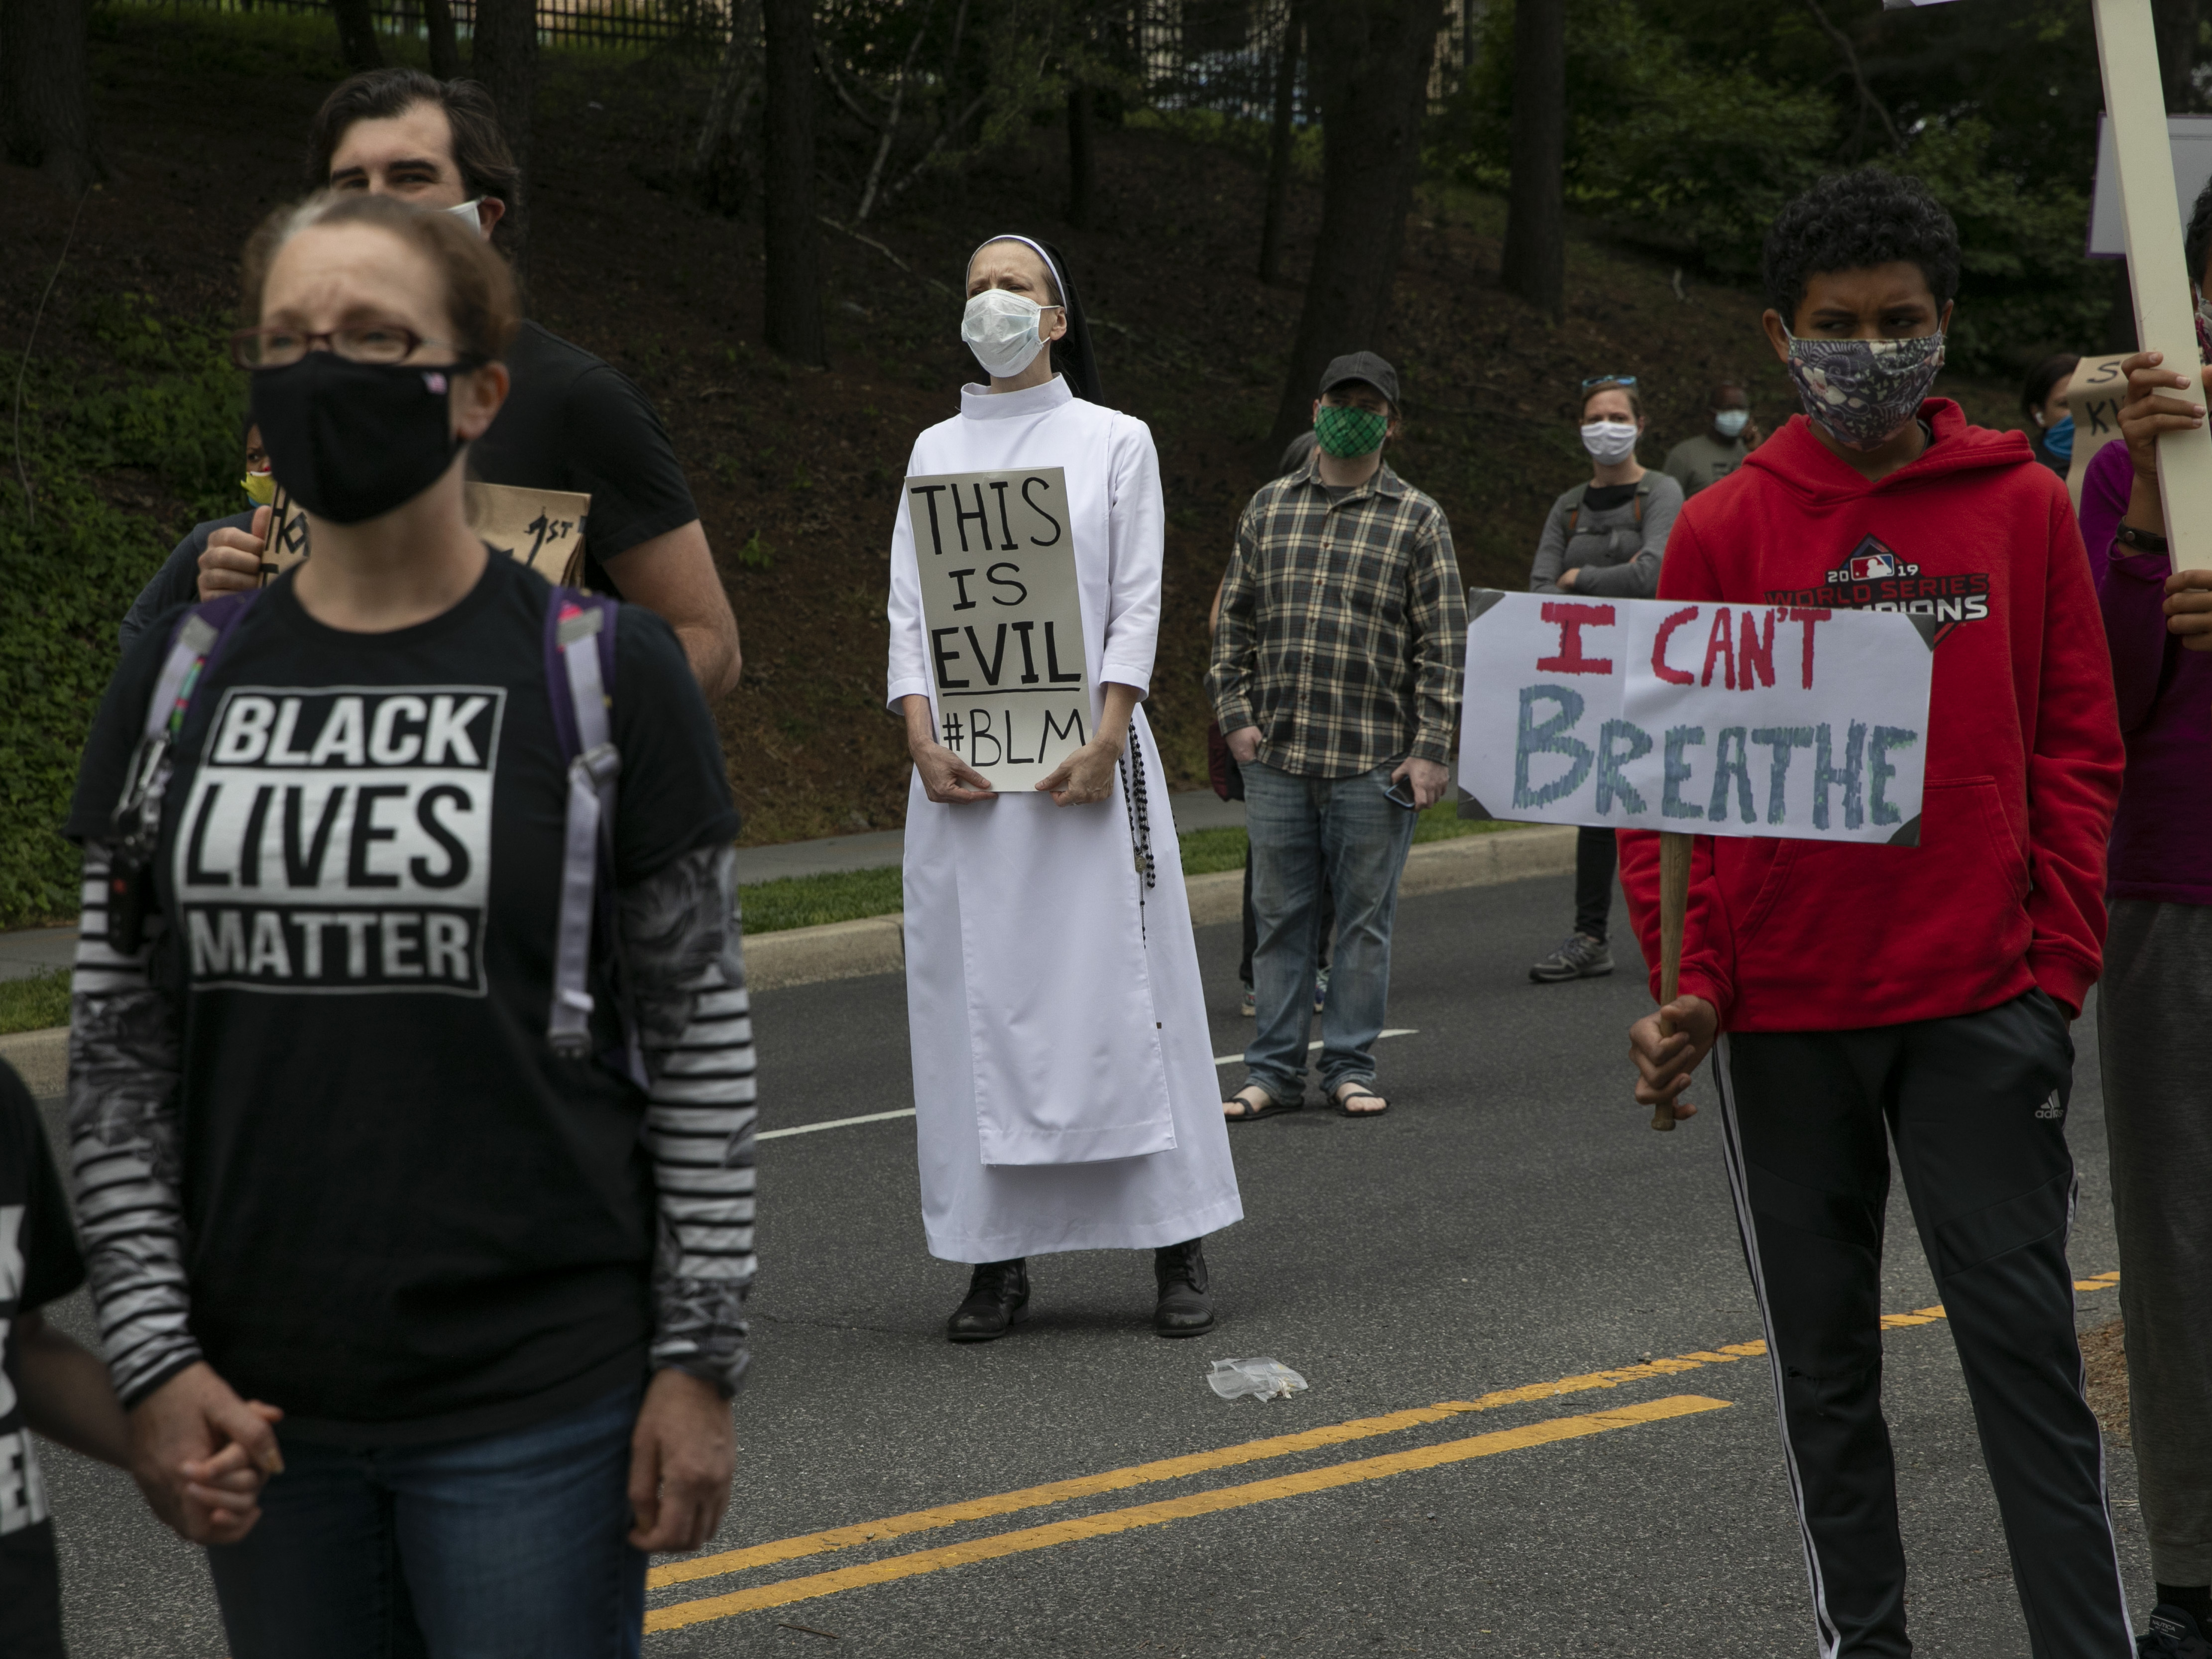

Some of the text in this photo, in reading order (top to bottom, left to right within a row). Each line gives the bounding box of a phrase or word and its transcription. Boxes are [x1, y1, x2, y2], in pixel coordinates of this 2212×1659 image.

[911, 476, 1061, 555] THIS
[948, 562, 1028, 611] IS
[1766, 575, 1987, 607] WORLD SERIES
[1828, 564, 1918, 583] 20 19
[931, 621, 1081, 689] EVIL
[1536, 602, 1832, 691] I CAN'T
[212, 696, 489, 765] BLACK
[942, 709, 1086, 767] #BLM
[1513, 684, 1918, 830] BREATHE
[186, 784, 472, 889] LIVES
[187, 910, 470, 980] MATTER
[2152, 1620, 2176, 1632] NAUTICA
